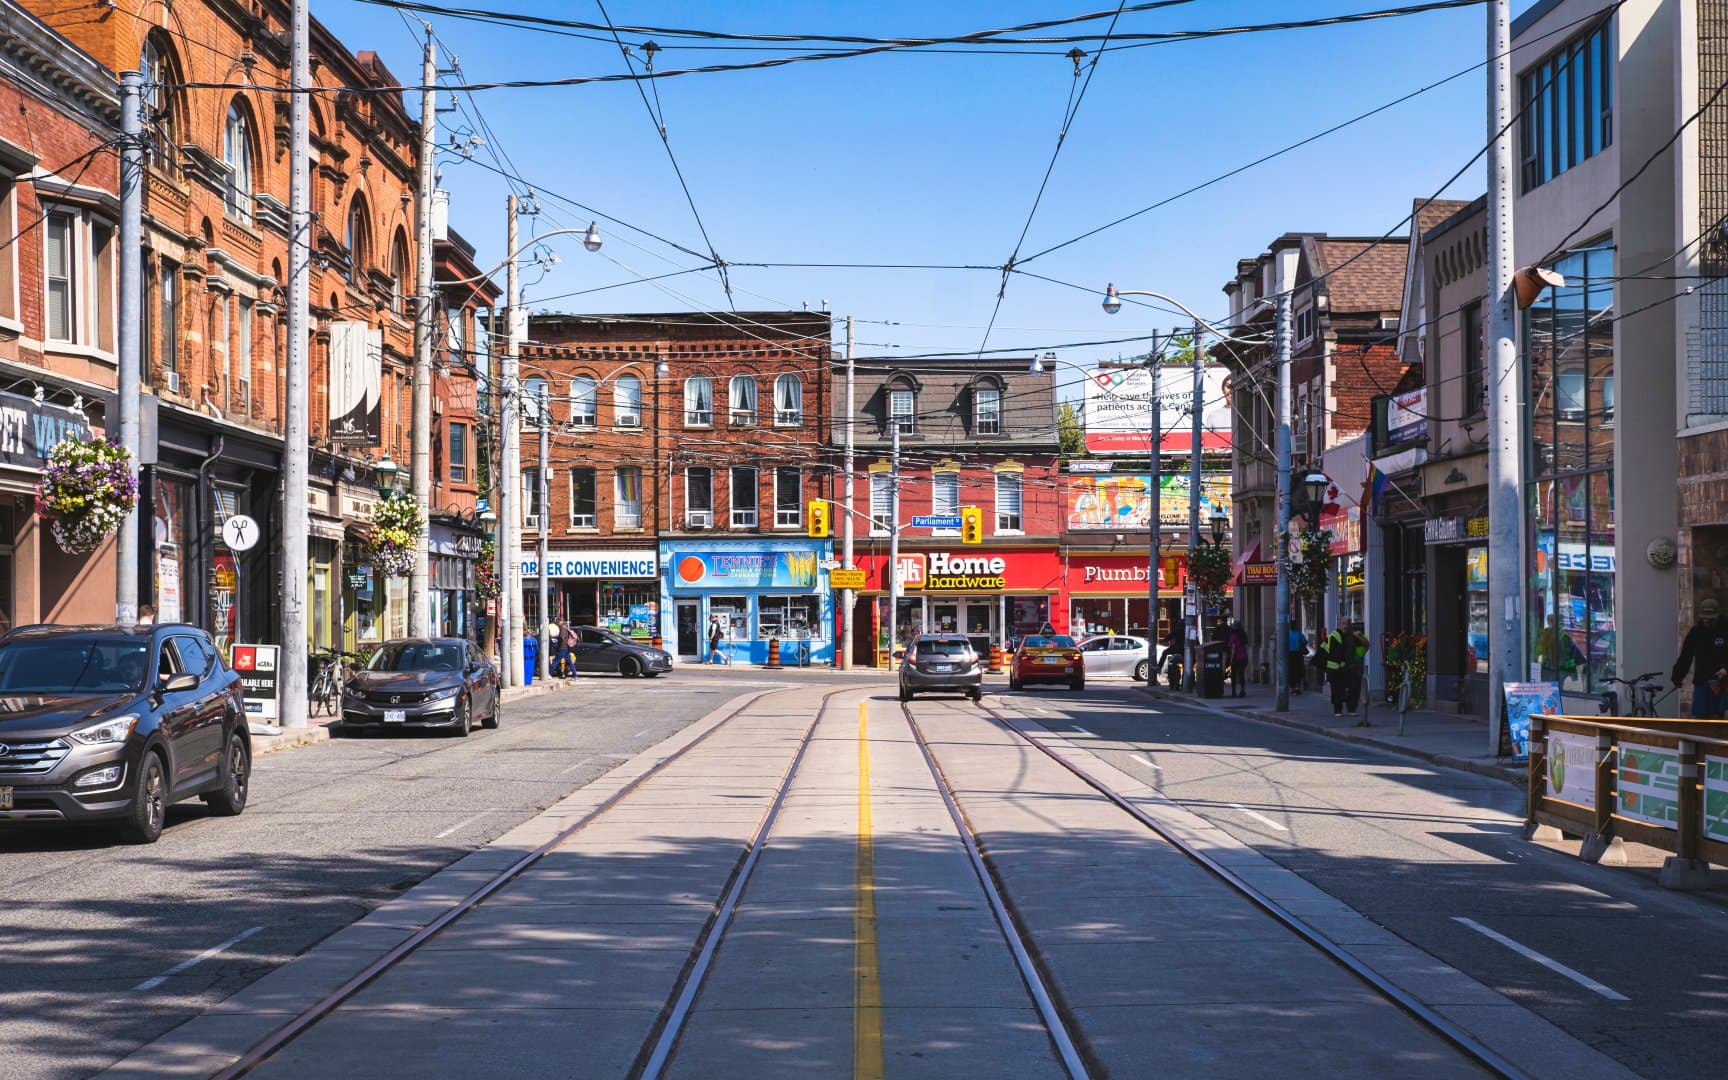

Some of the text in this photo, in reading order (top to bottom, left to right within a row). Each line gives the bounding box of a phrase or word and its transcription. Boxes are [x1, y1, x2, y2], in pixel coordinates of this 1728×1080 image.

[1097, 402, 1135, 412] patients
[0, 406, 27, 455] ET
[915, 517, 954, 526] Parliament
[566, 560, 654, 576] CONVENIENCE
[929, 553, 1006, 575] Home
[1085, 566, 1165, 581] Plumbin
[928, 575, 1006, 588] hardware
